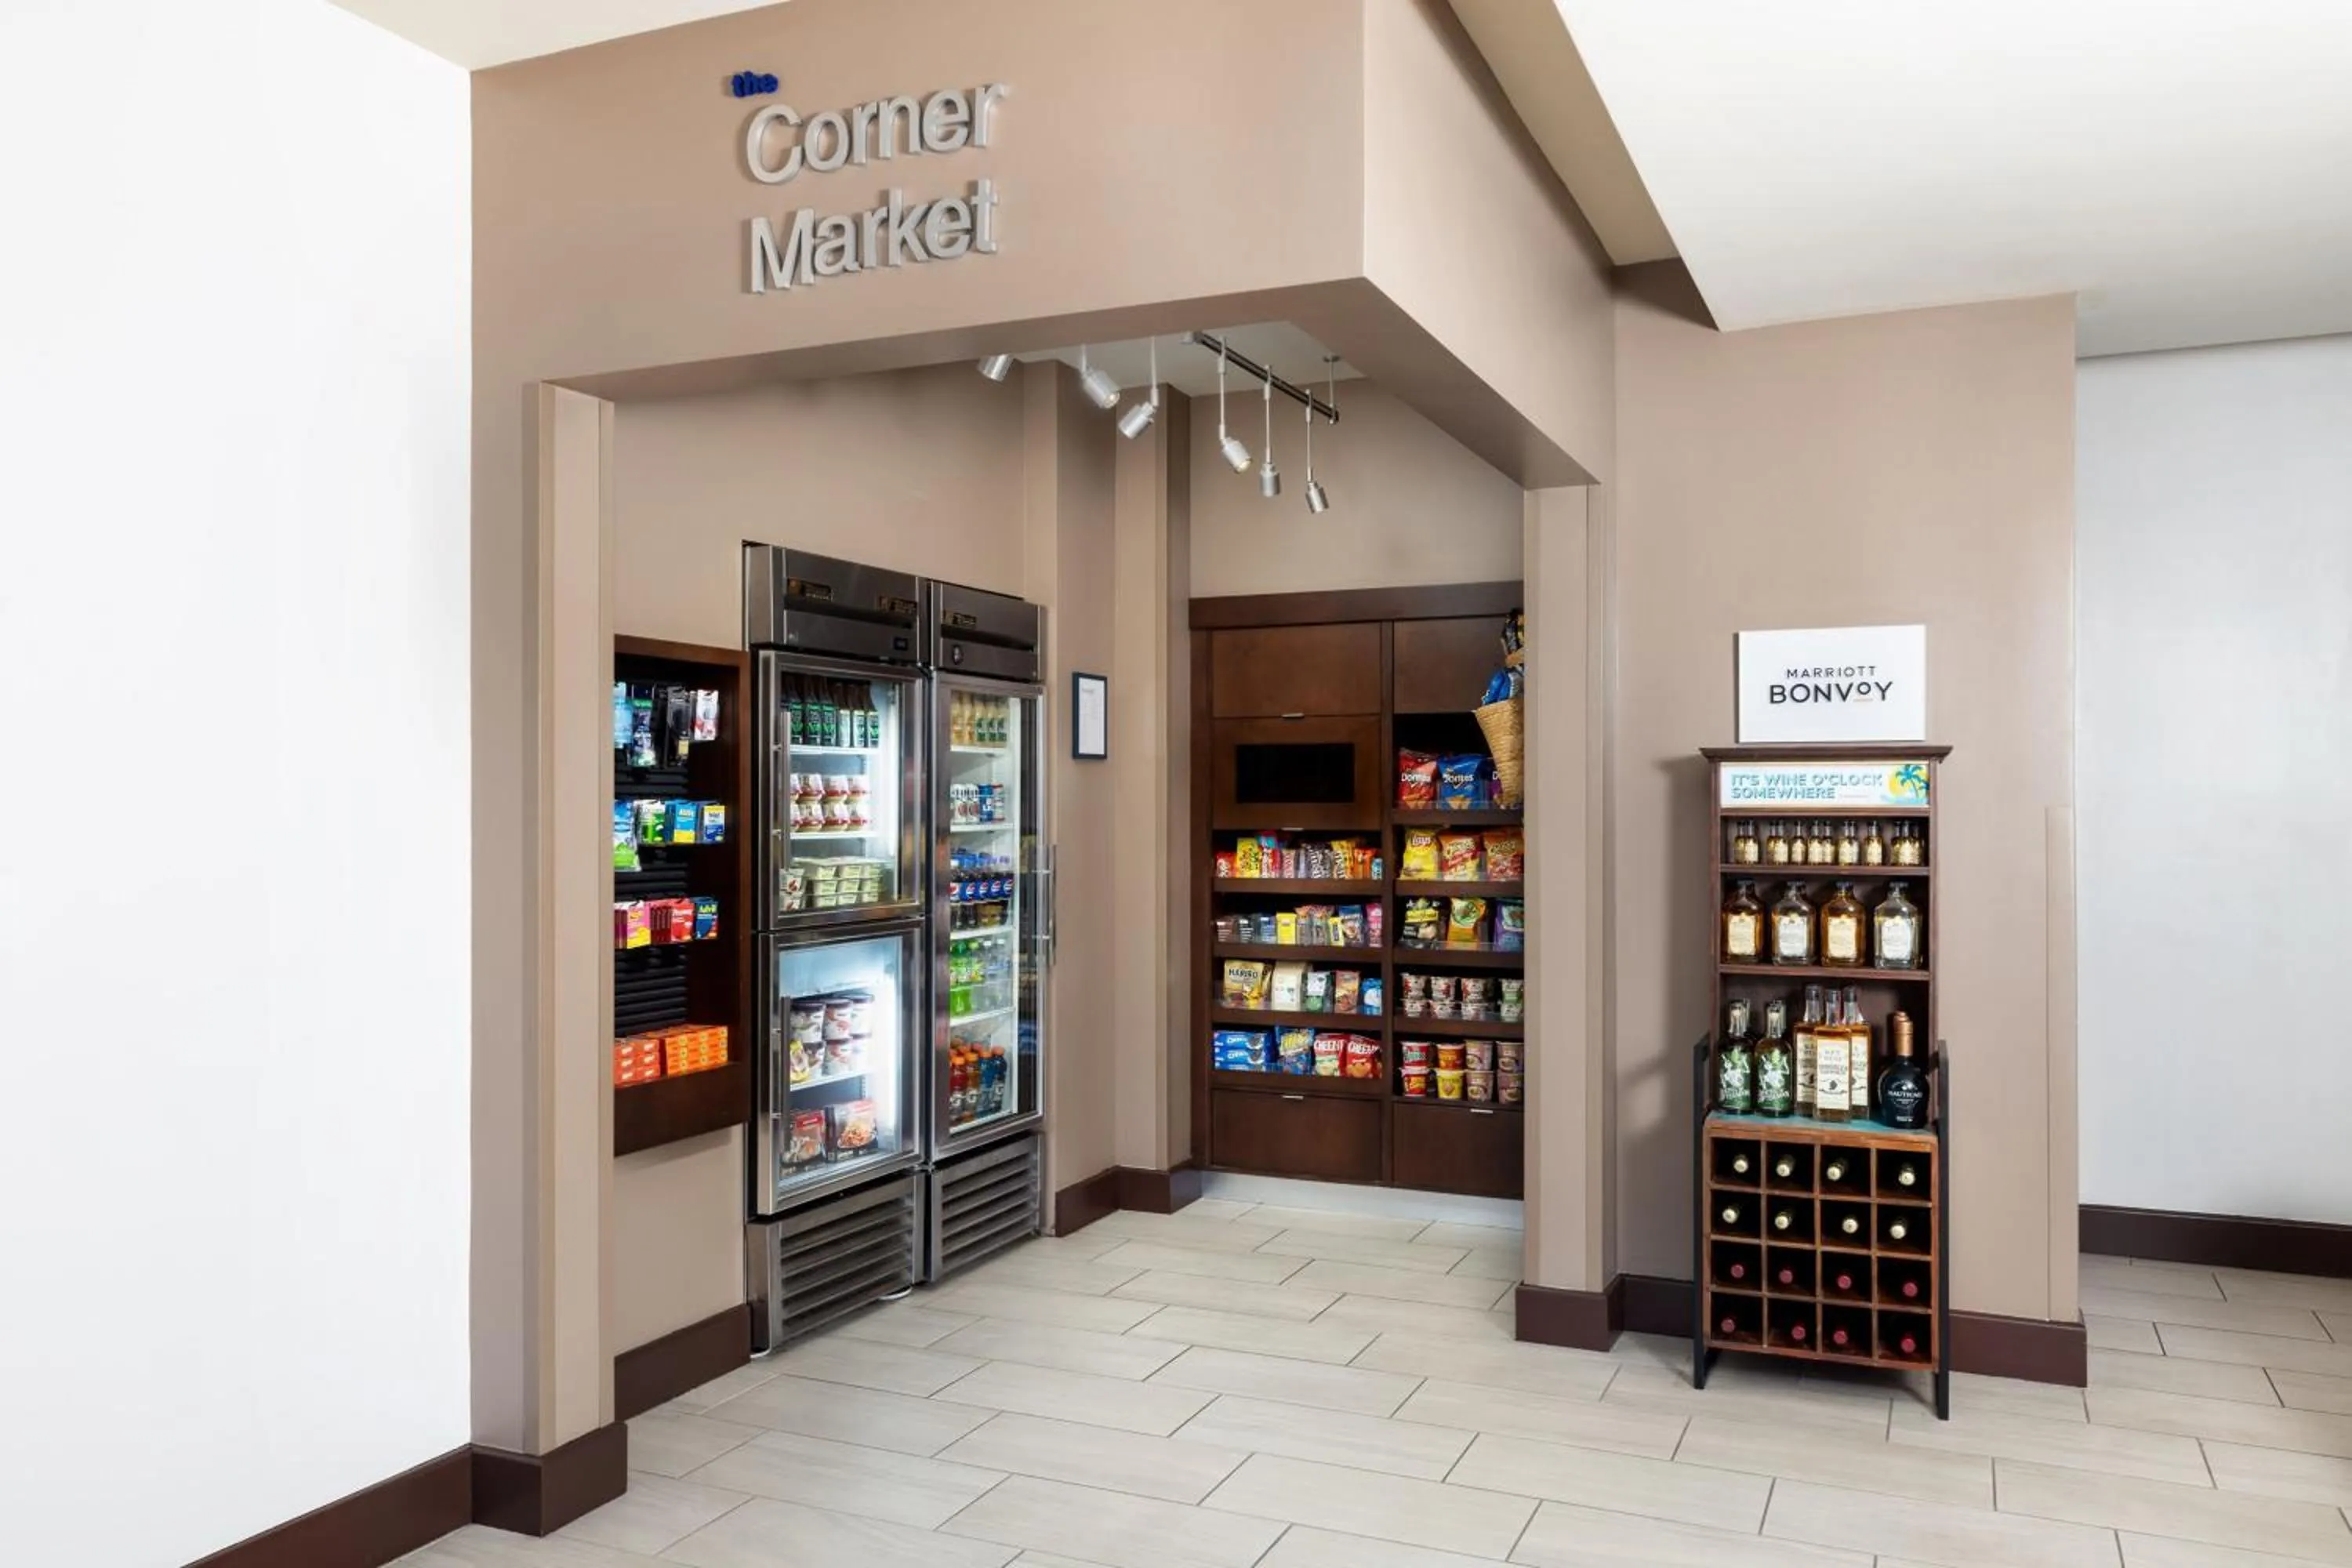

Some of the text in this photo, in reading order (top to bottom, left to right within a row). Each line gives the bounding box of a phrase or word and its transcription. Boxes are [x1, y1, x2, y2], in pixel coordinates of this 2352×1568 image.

[732, 71, 779, 97] the
[746, 82, 1008, 183] Corner
[750, 179, 999, 293] Market
[1786, 666, 1876, 679] MARRIOTT
[1769, 681, 1893, 704] BONVOY
[1730, 773, 1883, 786] IT'S WINE O'CLOCK
[1730, 787, 1836, 799] SOMEWHERE
